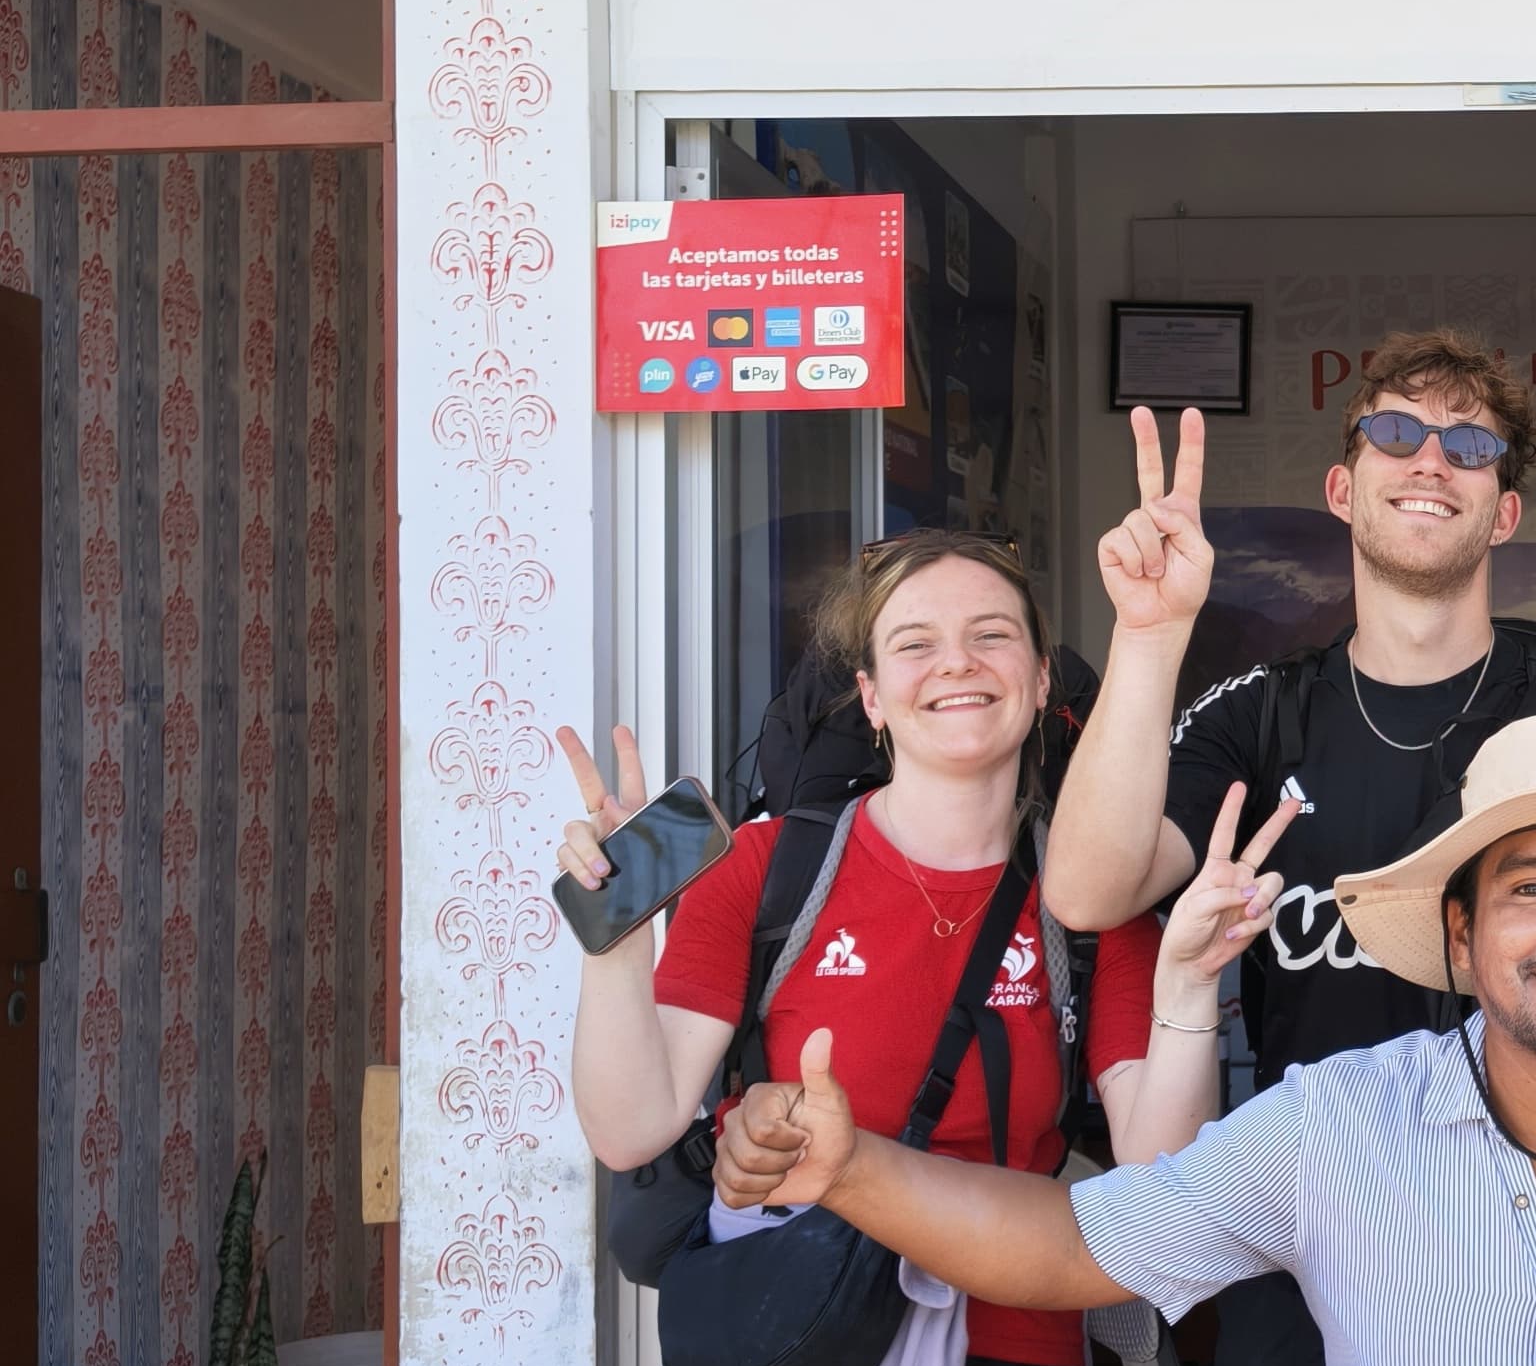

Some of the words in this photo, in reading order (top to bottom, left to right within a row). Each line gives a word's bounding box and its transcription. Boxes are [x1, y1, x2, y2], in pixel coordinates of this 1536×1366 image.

[610, 214, 661, 232] izipay
[668, 247, 780, 267] Aceptamos
[784, 244, 840, 262] todas
[642, 271, 671, 288] las
[675, 270, 751, 292] tarjetas
[755, 273, 768, 290] y
[771, 268, 864, 286] billeteras
[637, 321, 696, 341] VISA
[644, 369, 671, 385] plin
[752, 366, 779, 383] Pay
[829, 363, 858, 381] Pay
[991, 982, 1039, 996] RANC
